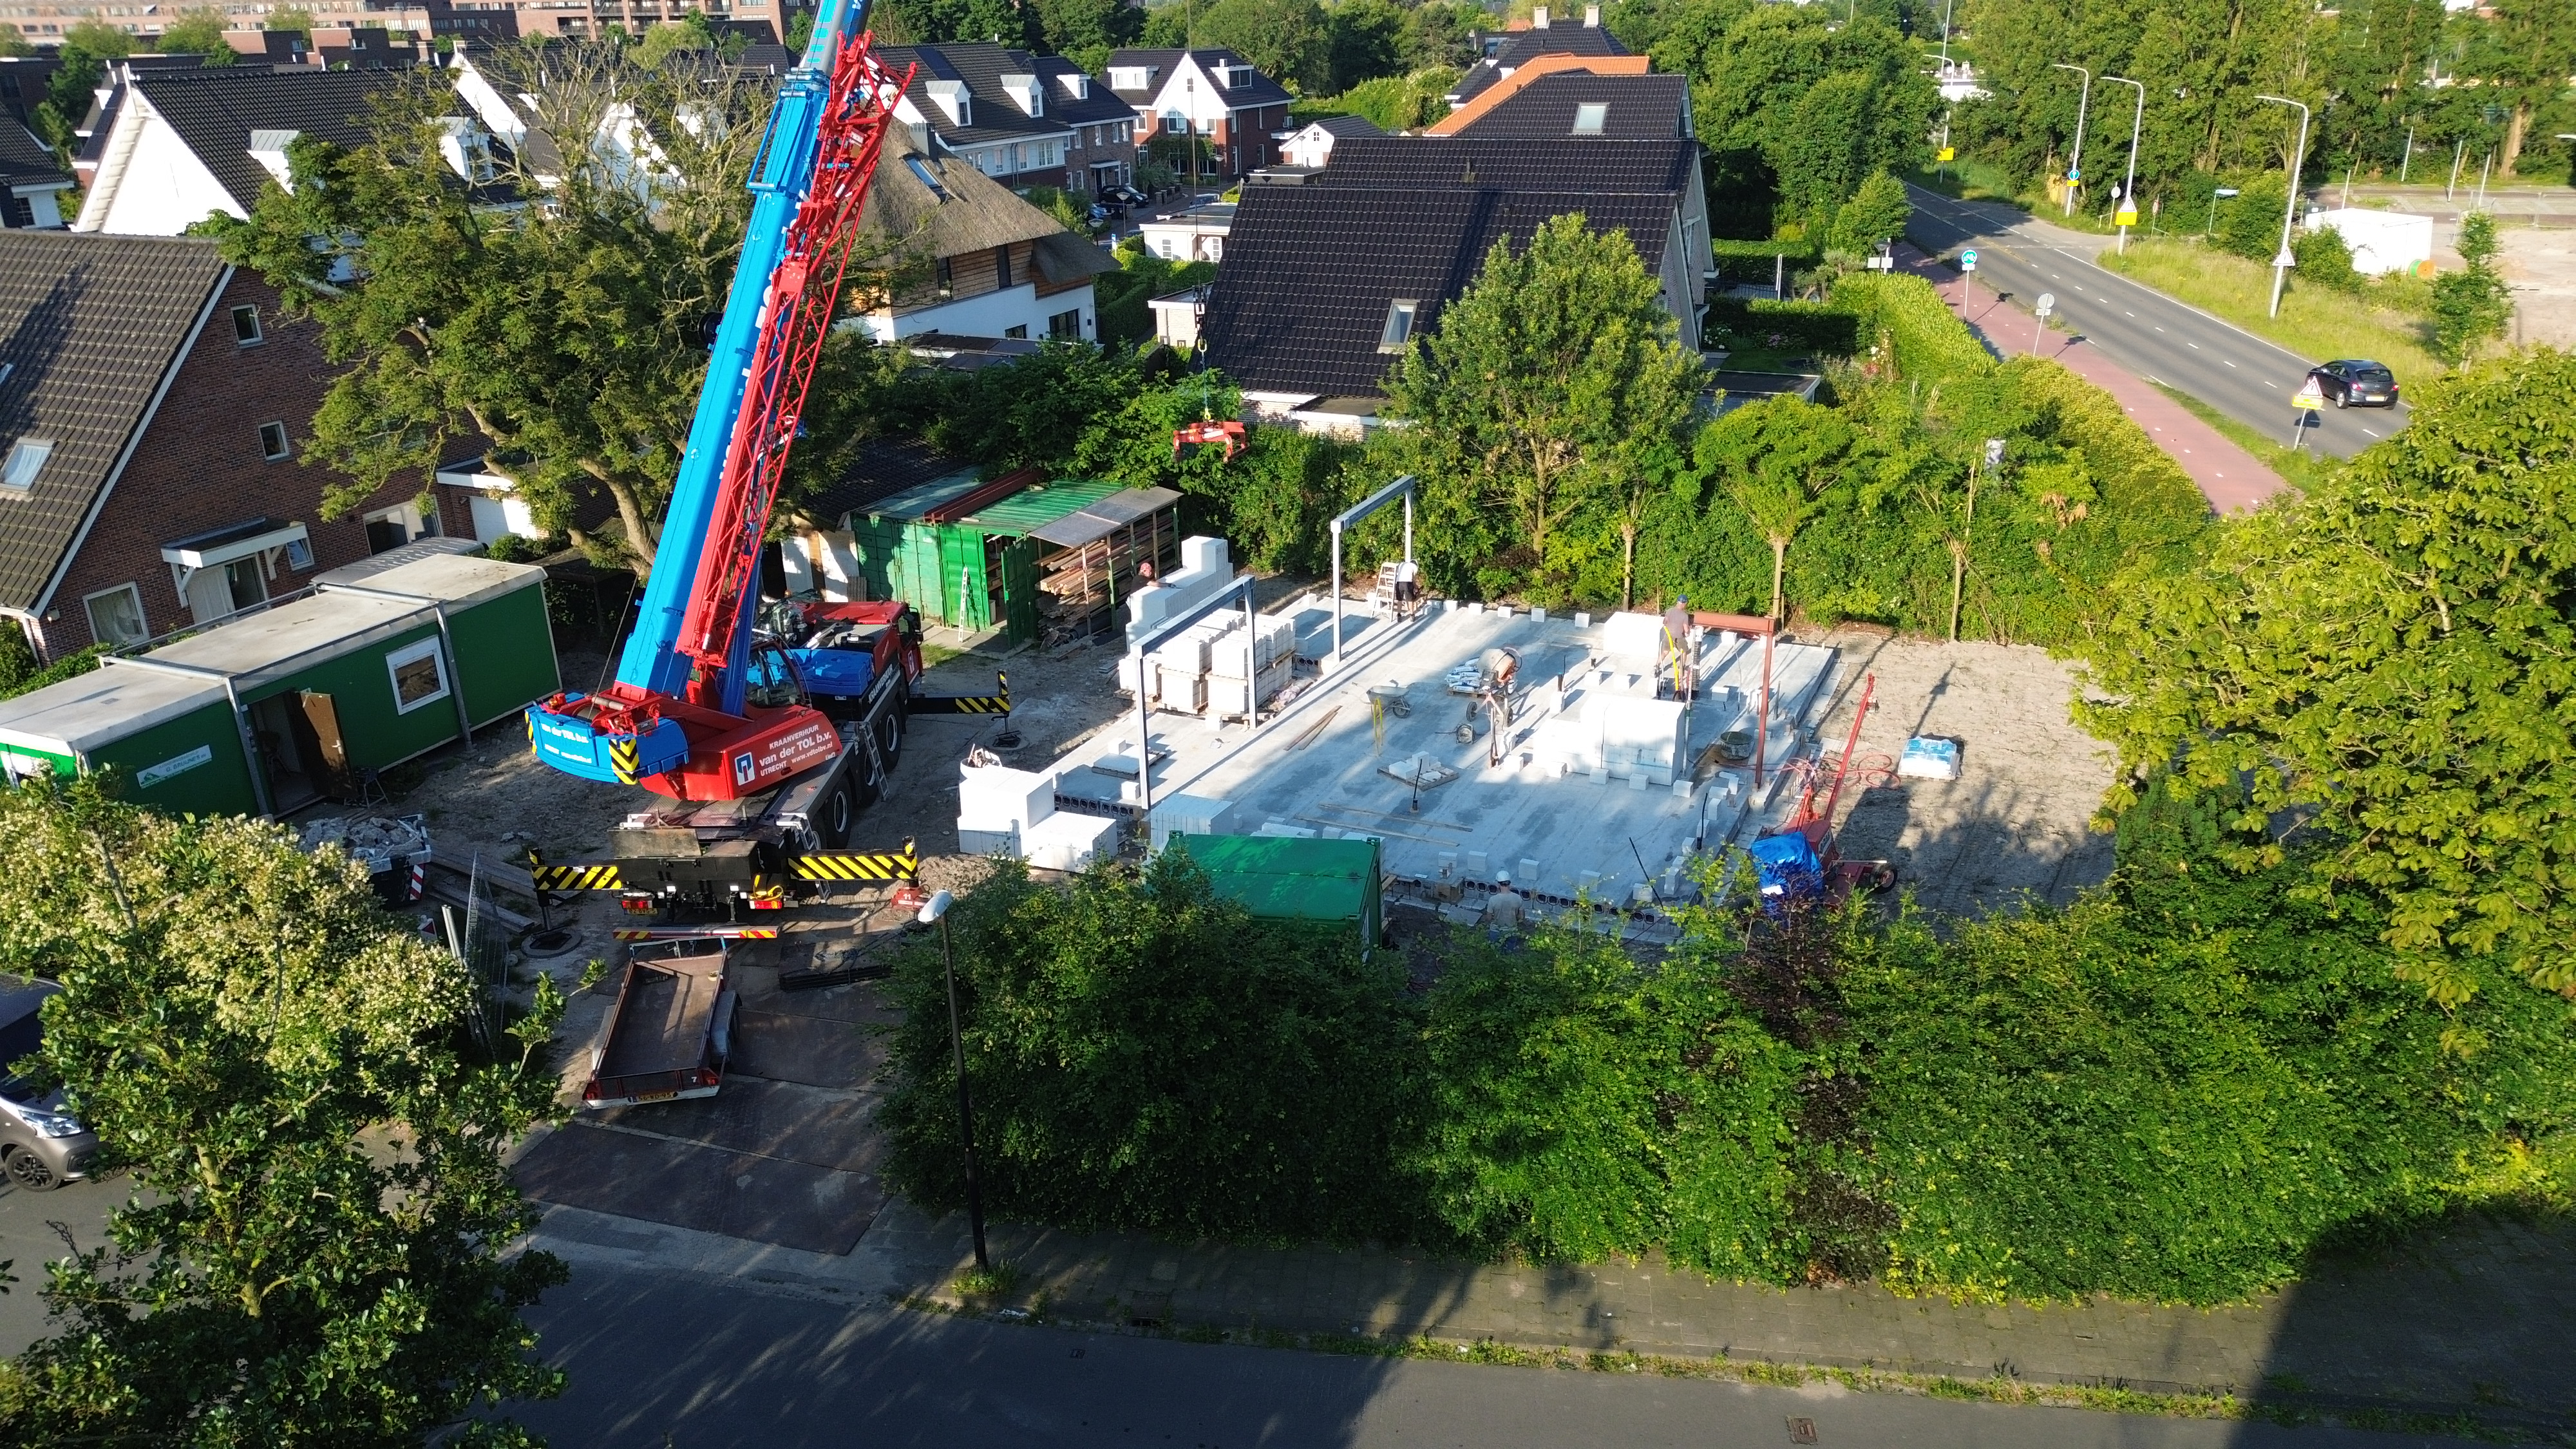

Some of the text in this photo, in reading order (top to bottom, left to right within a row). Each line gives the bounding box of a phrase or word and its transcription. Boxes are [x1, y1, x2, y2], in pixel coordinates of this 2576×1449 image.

[759, 732, 832, 767] van der TOL b.v.
[769, 724, 819, 750] KRAANVERHUUR
[761, 761, 787, 777] UTRECHT
[791, 741, 833, 764] www.vdtolbv.nl
